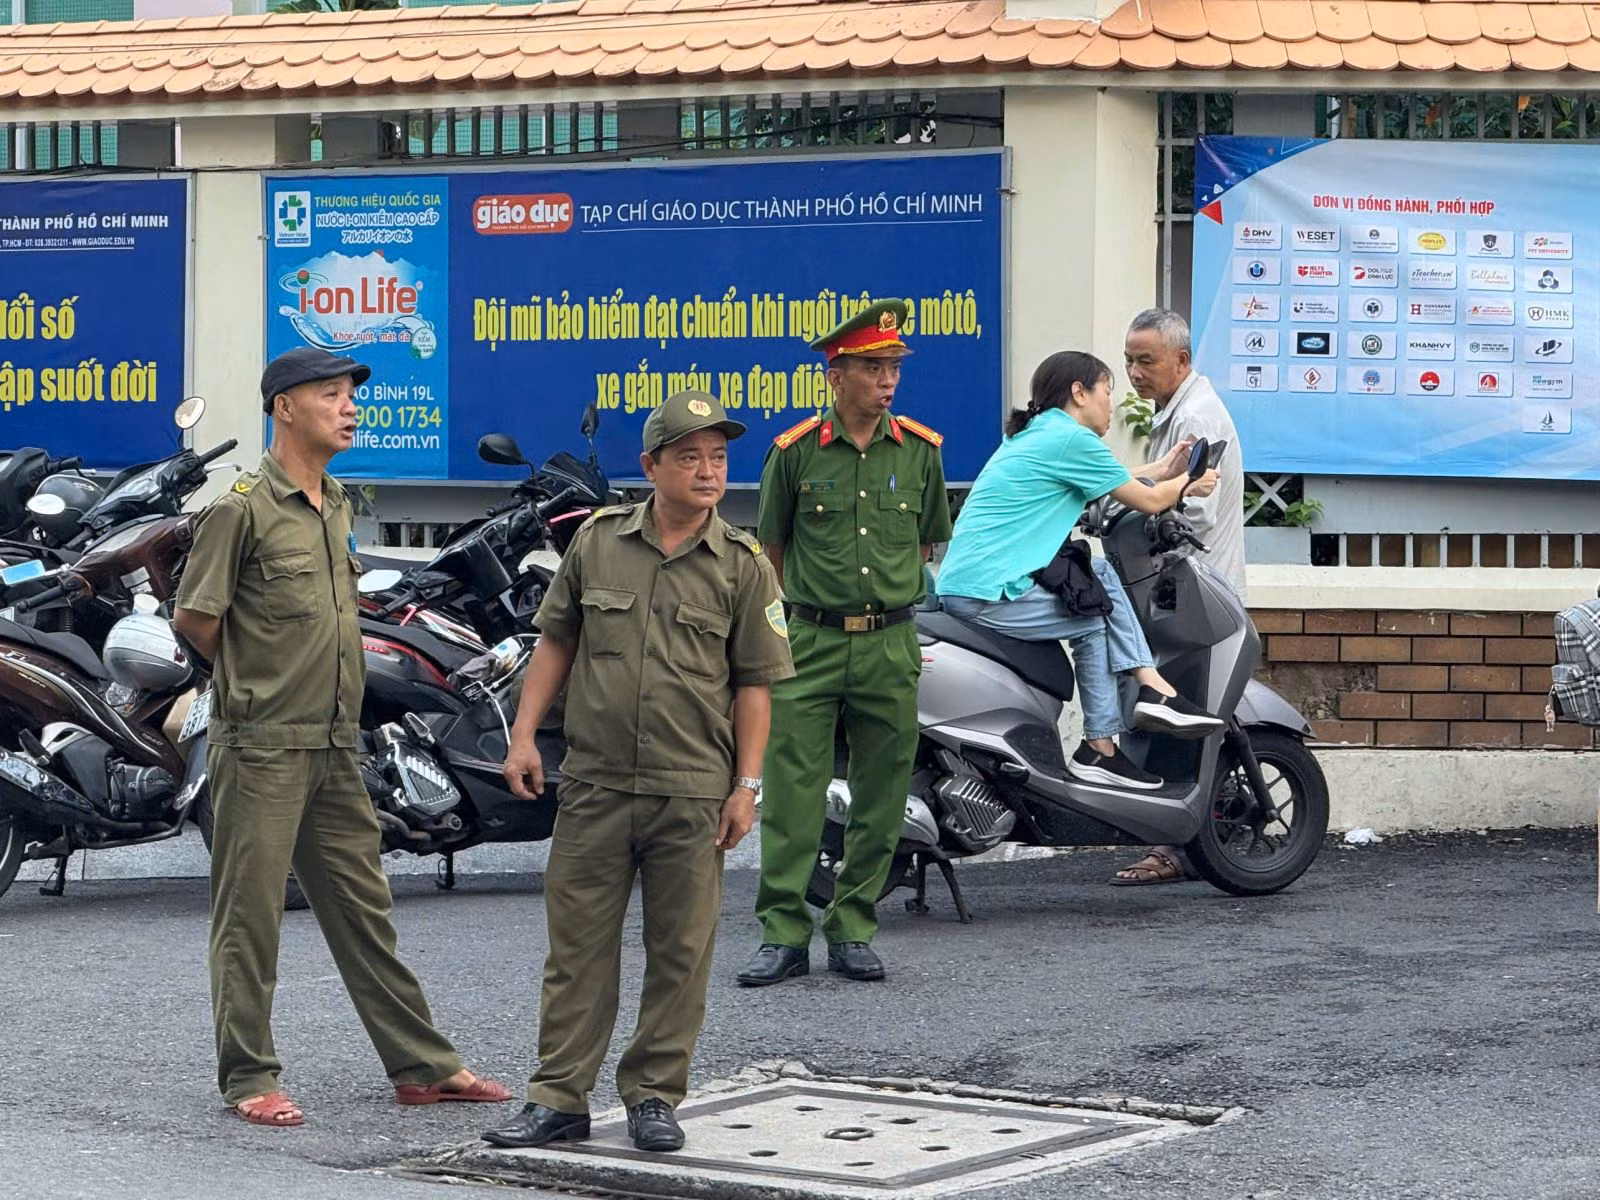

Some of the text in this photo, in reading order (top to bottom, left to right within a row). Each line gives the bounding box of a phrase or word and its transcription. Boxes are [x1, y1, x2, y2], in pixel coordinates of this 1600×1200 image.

[314, 190, 441, 208] THƯƠNG HIỆU QUỐC GIA
[580, 191, 982, 228] TẠP CHÍ GIÁO DỤC THÀNH PHỐ HỒ CHÍ MINH
[1313, 195, 1338, 208] ĐƠN
[1342, 197, 1354, 212] VỊ
[1437, 197, 1465, 214] PHỐI
[1470, 200, 1495, 217] HỢP
[0, 212, 168, 230] HÀNH PHỐ HỒ CHÍ MINH
[316, 212, 345, 226] NƯỚC
[395, 213, 416, 226] CAO
[418, 209, 440, 226] CẤP
[477, 198, 570, 229] giáo dục
[342, 230, 412, 243] アルカリイオンの水
[1297, 230, 1335, 240] WESET
[361, 277, 416, 314] Life
[40, 296, 80, 340] số
[474, 298, 506, 352] Đội
[510, 295, 541, 341] mũ
[546, 290, 583, 340] bảo
[588, 288, 639, 339] hiểm
[644, 295, 678, 349] đạt
[682, 286, 747, 338] chuẩn
[752, 292, 784, 337] khi
[789, 288, 836, 342] ngồi
[40, 358, 104, 402] suốt
[110, 360, 157, 402] đời
[374, 382, 408, 400] BÌNH
[412, 386, 434, 400] 19L
[596, 372, 620, 409] xe
[624, 358, 663, 414] gắn
[719, 372, 743, 408] xe
[748, 364, 787, 419] đạp
[355, 406, 442, 428] 900 1734
